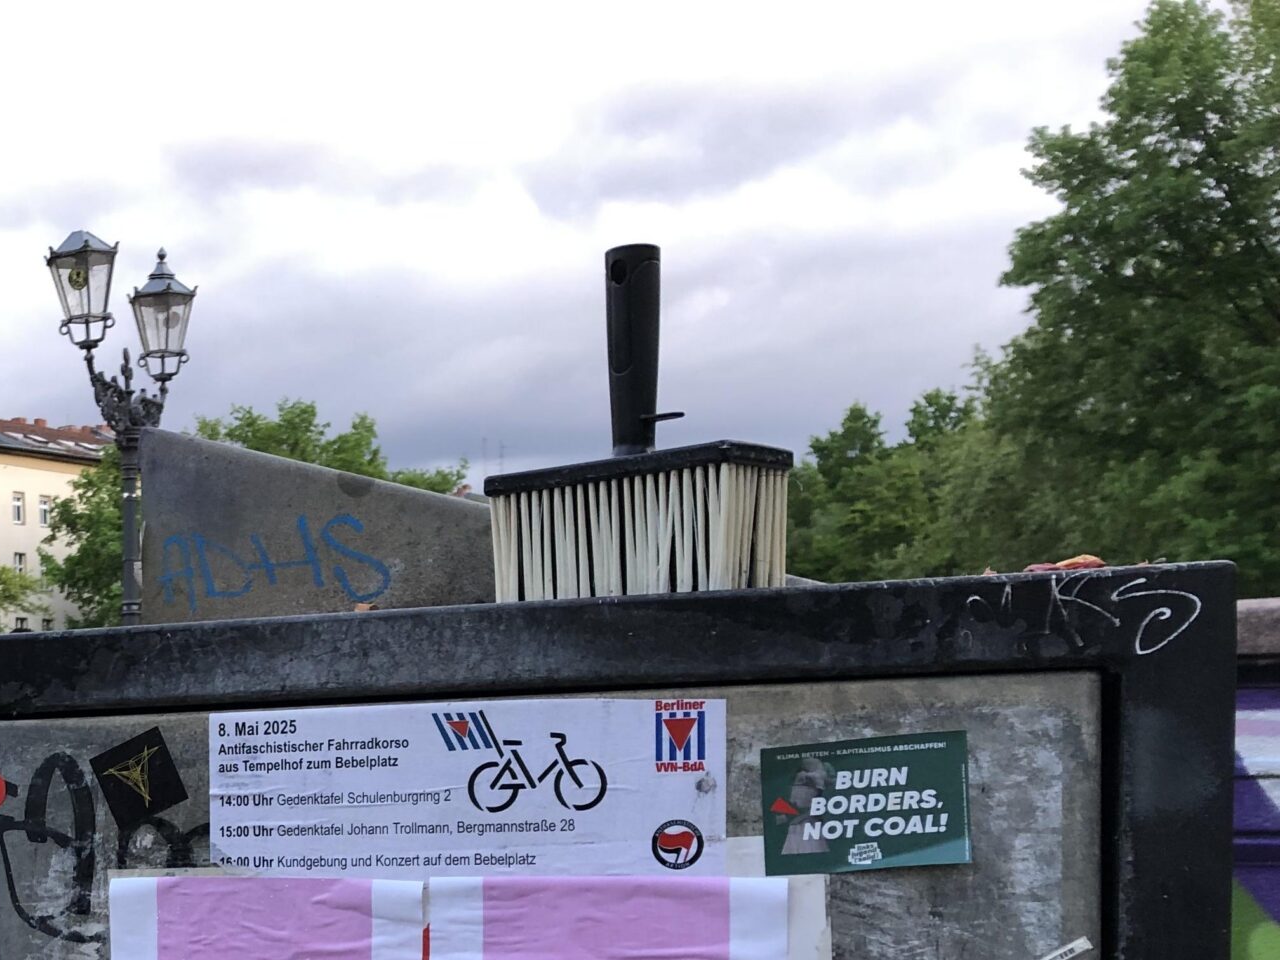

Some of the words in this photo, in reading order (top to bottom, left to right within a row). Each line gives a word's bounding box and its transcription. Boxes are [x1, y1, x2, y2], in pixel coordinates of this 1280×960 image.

[157, 514, 392, 615] ADHS
[655, 700, 706, 712] Berliner
[218, 723, 230, 737] 8.
[235, 721, 259, 736] Mai
[264, 720, 297, 735] 2025
[218, 740, 324, 756] Antifaschistischer
[327, 737, 409, 752] Fahrradkorso
[837, 745, 892, 756] KAPITALISMUS
[893, 741, 947, 752] ABSCHAFFEN!
[218, 761, 239, 773] aus
[242, 757, 303, 774] Tempelhof
[307, 760, 331, 770] zum
[335, 756, 399, 772] Bebelplatz
[656, 761, 705, 773] VVN-BdA
[835, 766, 909, 790] BURN
[219, 794, 250, 808] 14:00
[253, 794, 274, 807] Uhr
[276, 792, 344, 807] Gedenktafel
[347, 790, 440, 806] Schulenburgring
[444, 789, 452, 802] 2
[809, 789, 944, 816] BORDERS,
[219, 824, 250, 838] 15:00
[253, 824, 274, 838] Uhr
[276, 823, 344, 838] Gedenktafel
[347, 822, 389, 836] Johann
[393, 822, 454, 836] Trollmann,
[457, 819, 556, 836] Bergmannstraße
[560, 818, 576, 832] 28
[802, 818, 859, 841] NOT
[864, 813, 949, 837] COAL!
[253, 855, 274, 868] Uhr
[276, 854, 349, 871] Kundgebung
[351, 854, 372, 868] und
[375, 854, 420, 868] Konzert
[423, 854, 443, 866] auf
[446, 854, 470, 866] dem
[474, 852, 536, 868] Bebelplatz
